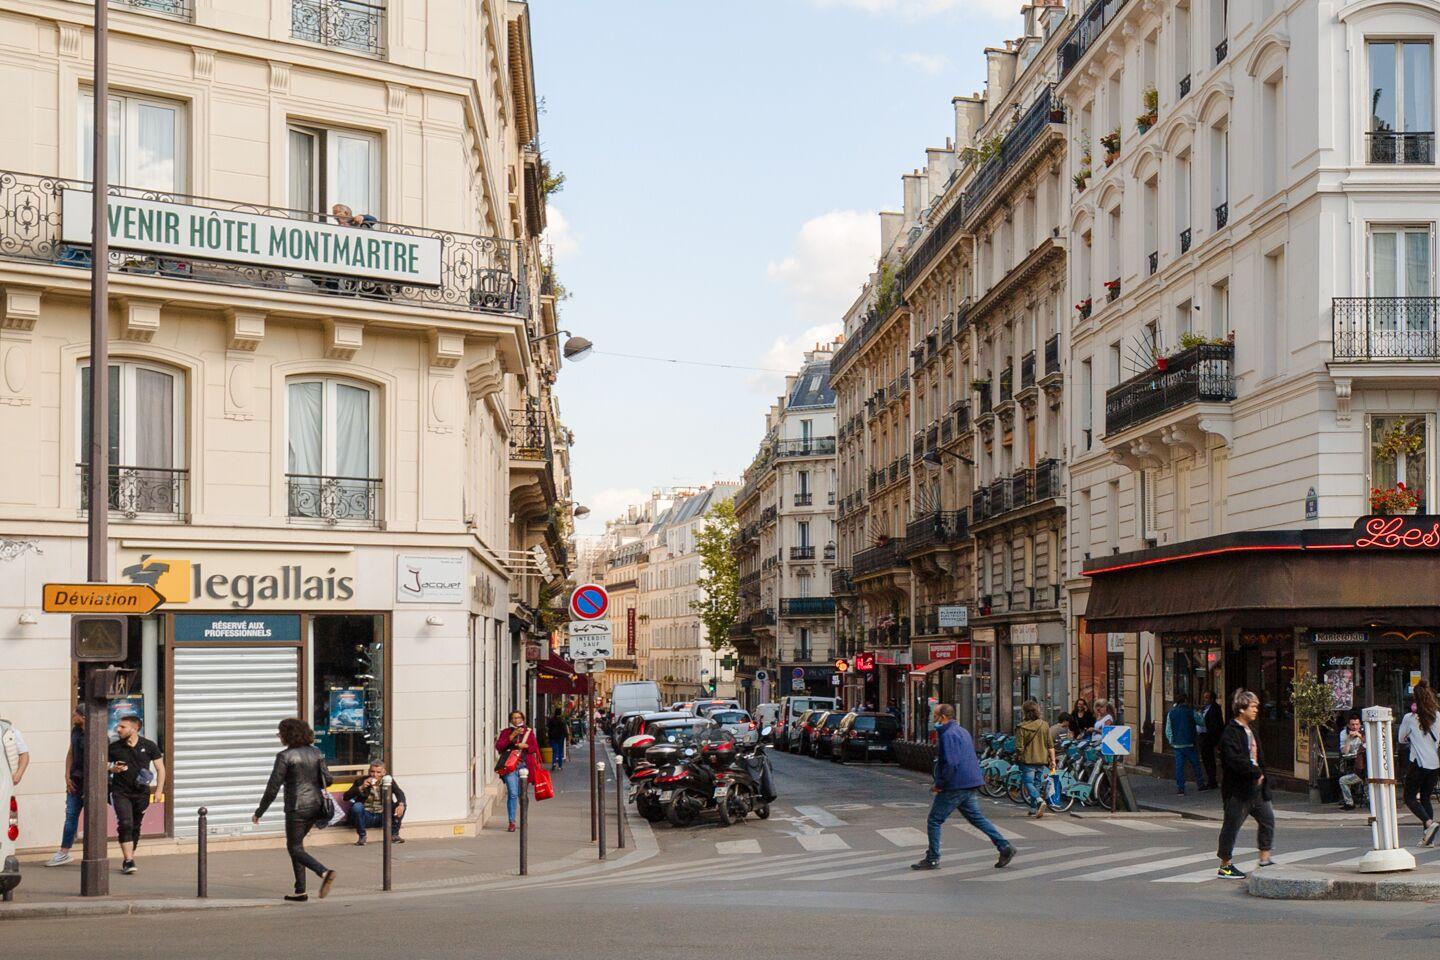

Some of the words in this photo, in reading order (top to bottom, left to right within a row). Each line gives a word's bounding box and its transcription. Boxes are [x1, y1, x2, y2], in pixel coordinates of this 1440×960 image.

[107, 203, 180, 245] VENIR
[190, 210, 260, 255] HÔTEL
[268, 225, 419, 274] MONTMARTRE
[1356, 517, 1440, 547] Les
[191, 562, 354, 608] legallais
[54, 590, 137, 607] Déviation
[204, 628, 272, 638] PROFESSIONNELS
[212, 620, 246, 630] RÉSERVÉ
[248, 622, 264, 630] AUX
